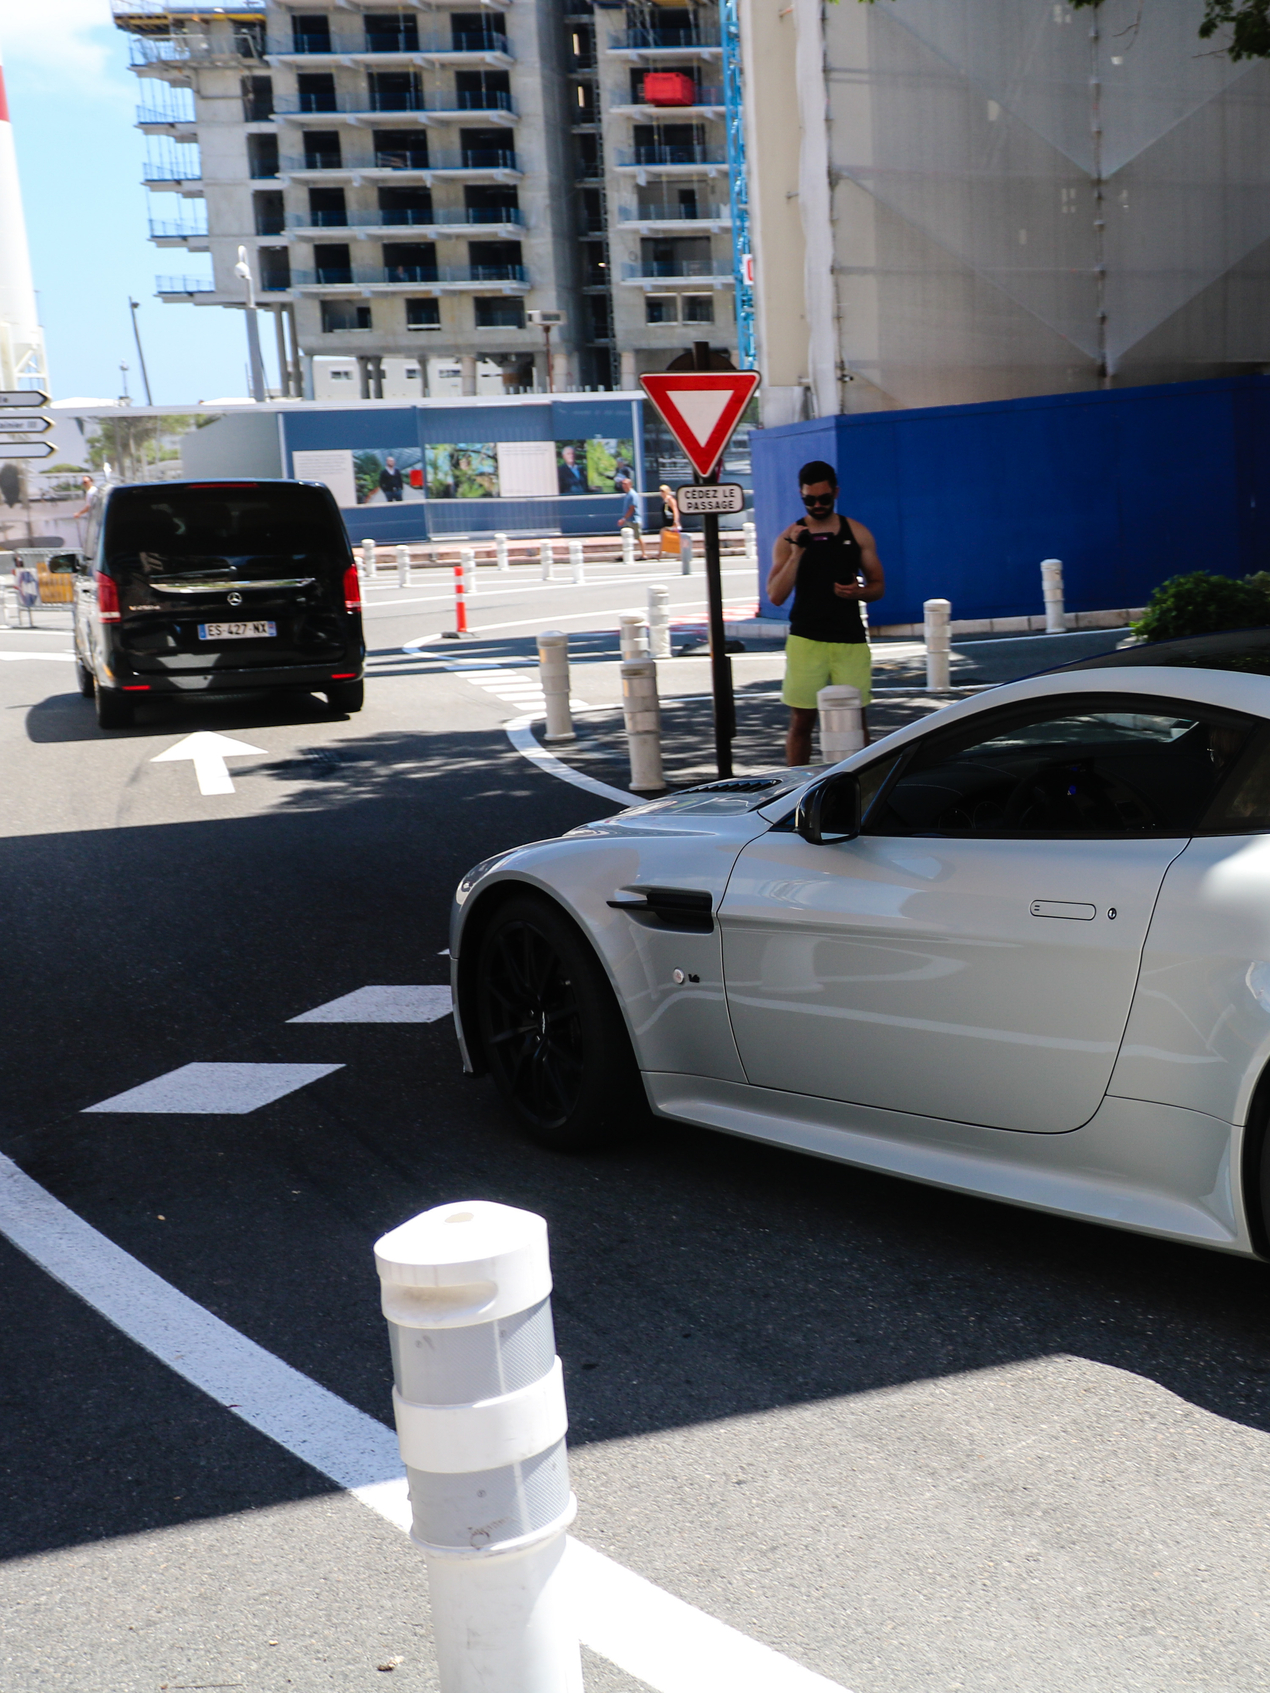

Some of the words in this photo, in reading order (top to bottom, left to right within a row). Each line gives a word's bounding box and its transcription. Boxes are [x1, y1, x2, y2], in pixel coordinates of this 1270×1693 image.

[684, 488, 718, 499] CÉDEZ
[722, 488, 735, 498] LE
[686, 500, 735, 511] PASSAGE
[207, 623, 268, 637] ES-427-NX
